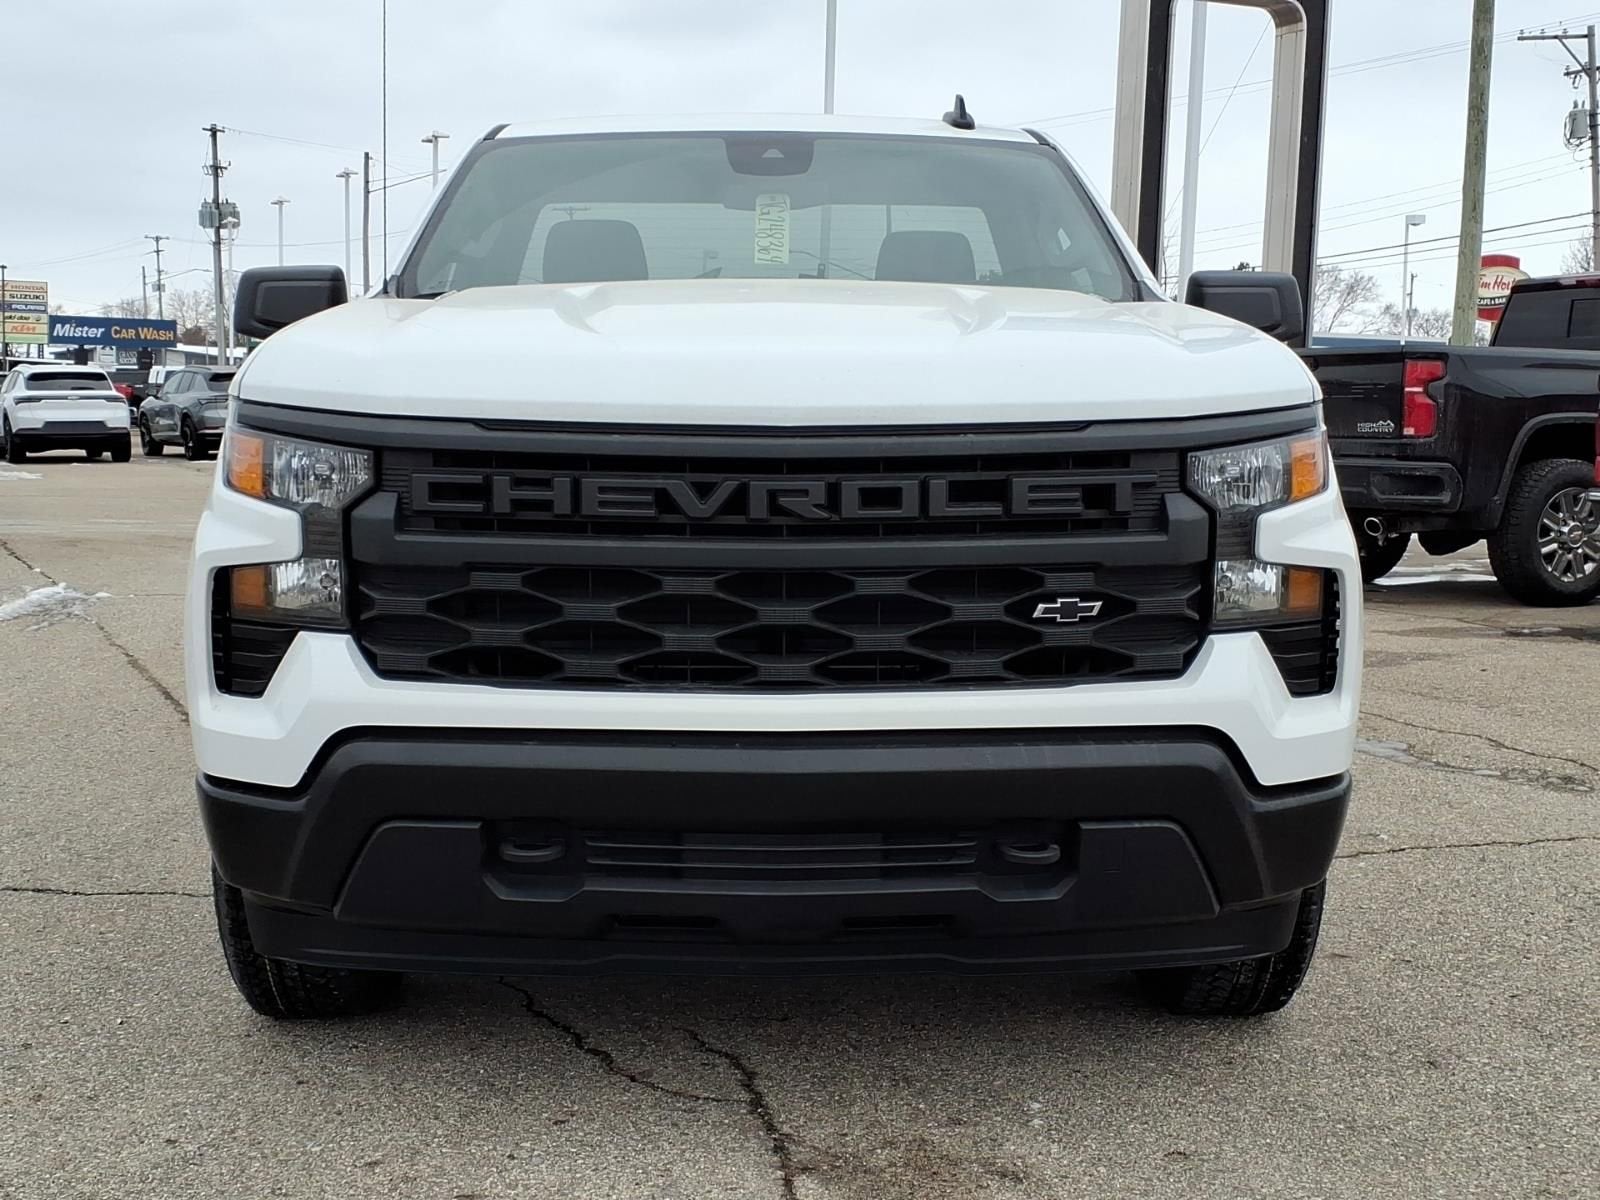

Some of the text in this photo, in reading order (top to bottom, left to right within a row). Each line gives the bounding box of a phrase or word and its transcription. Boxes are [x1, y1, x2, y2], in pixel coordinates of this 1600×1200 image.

[52, 322, 174, 341] Mister CAR WASH
[411, 472, 1159, 520] CHEVROLET
